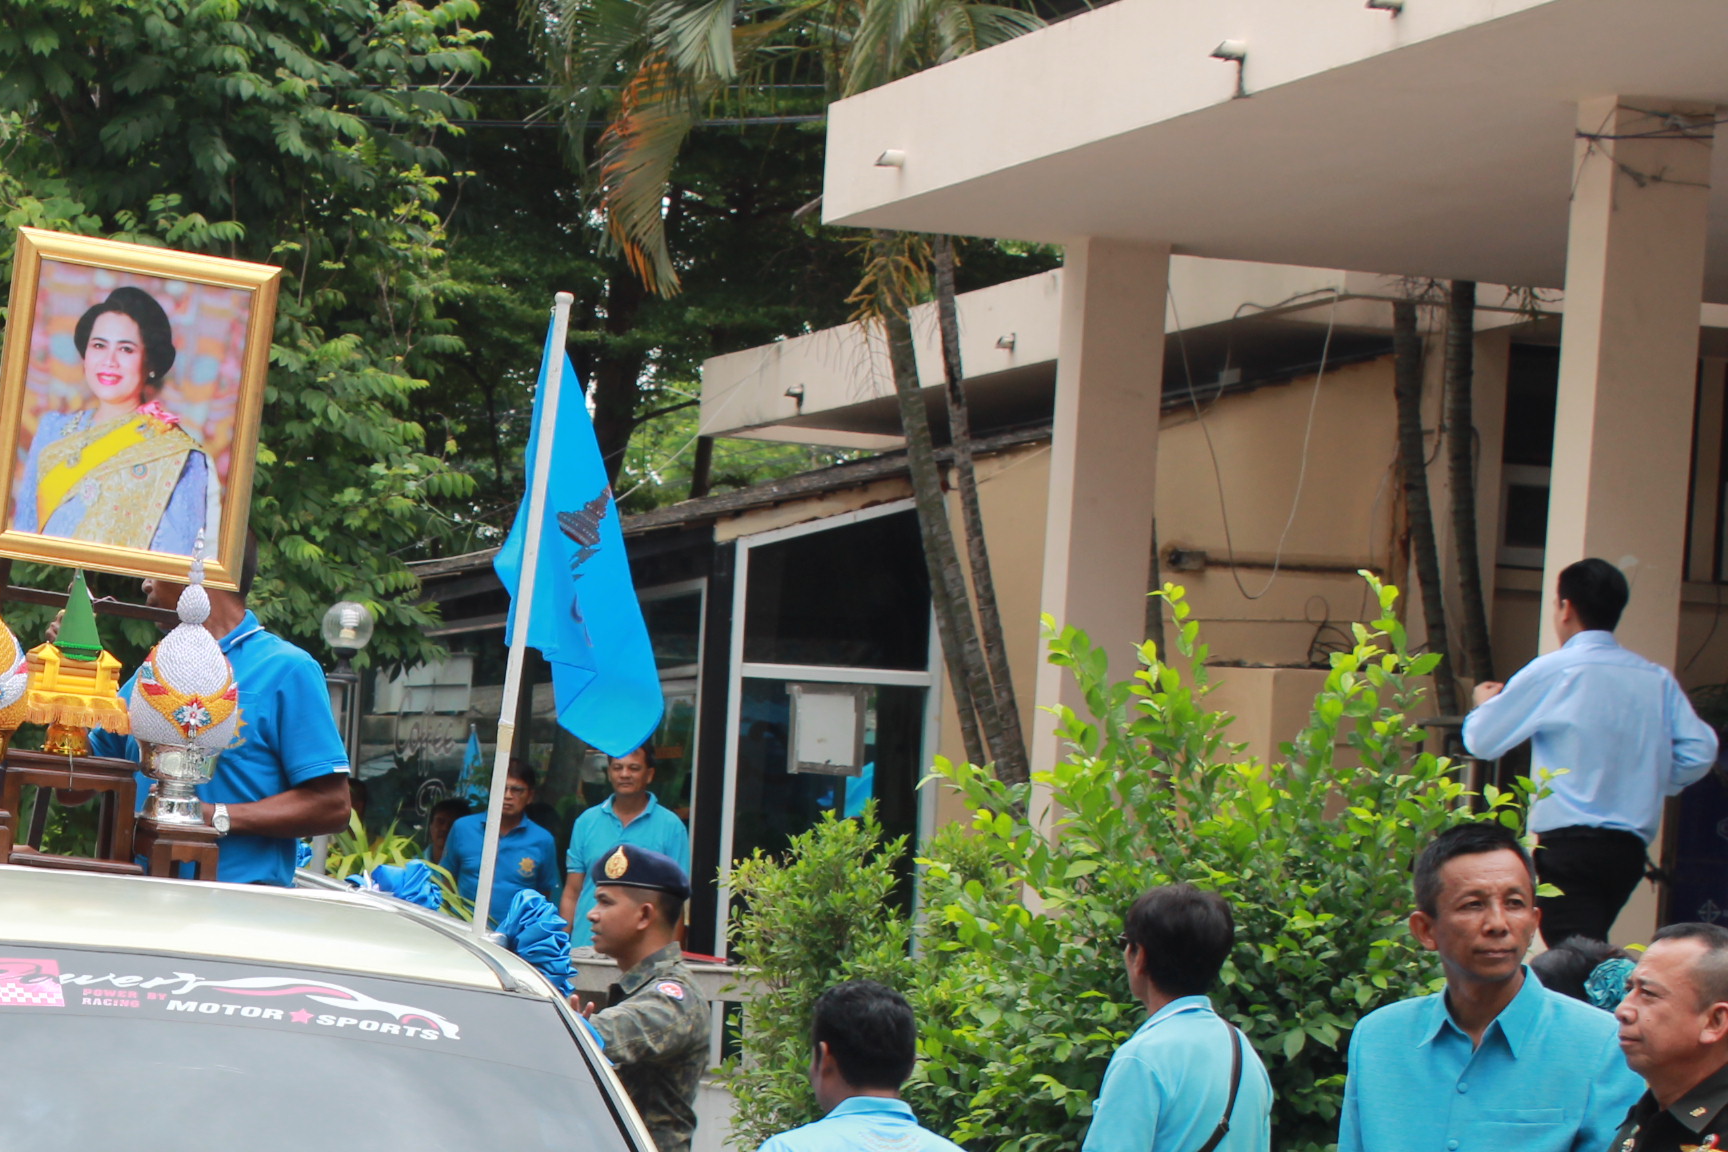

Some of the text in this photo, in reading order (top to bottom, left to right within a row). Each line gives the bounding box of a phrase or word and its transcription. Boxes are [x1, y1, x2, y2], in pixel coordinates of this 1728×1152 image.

[394, 687, 456, 777] Coffee
[82, 988, 167, 1000] POWER BY
[82, 997, 140, 1008] RACING
[166, 1000, 439, 1040] MOTOR SPORTS
